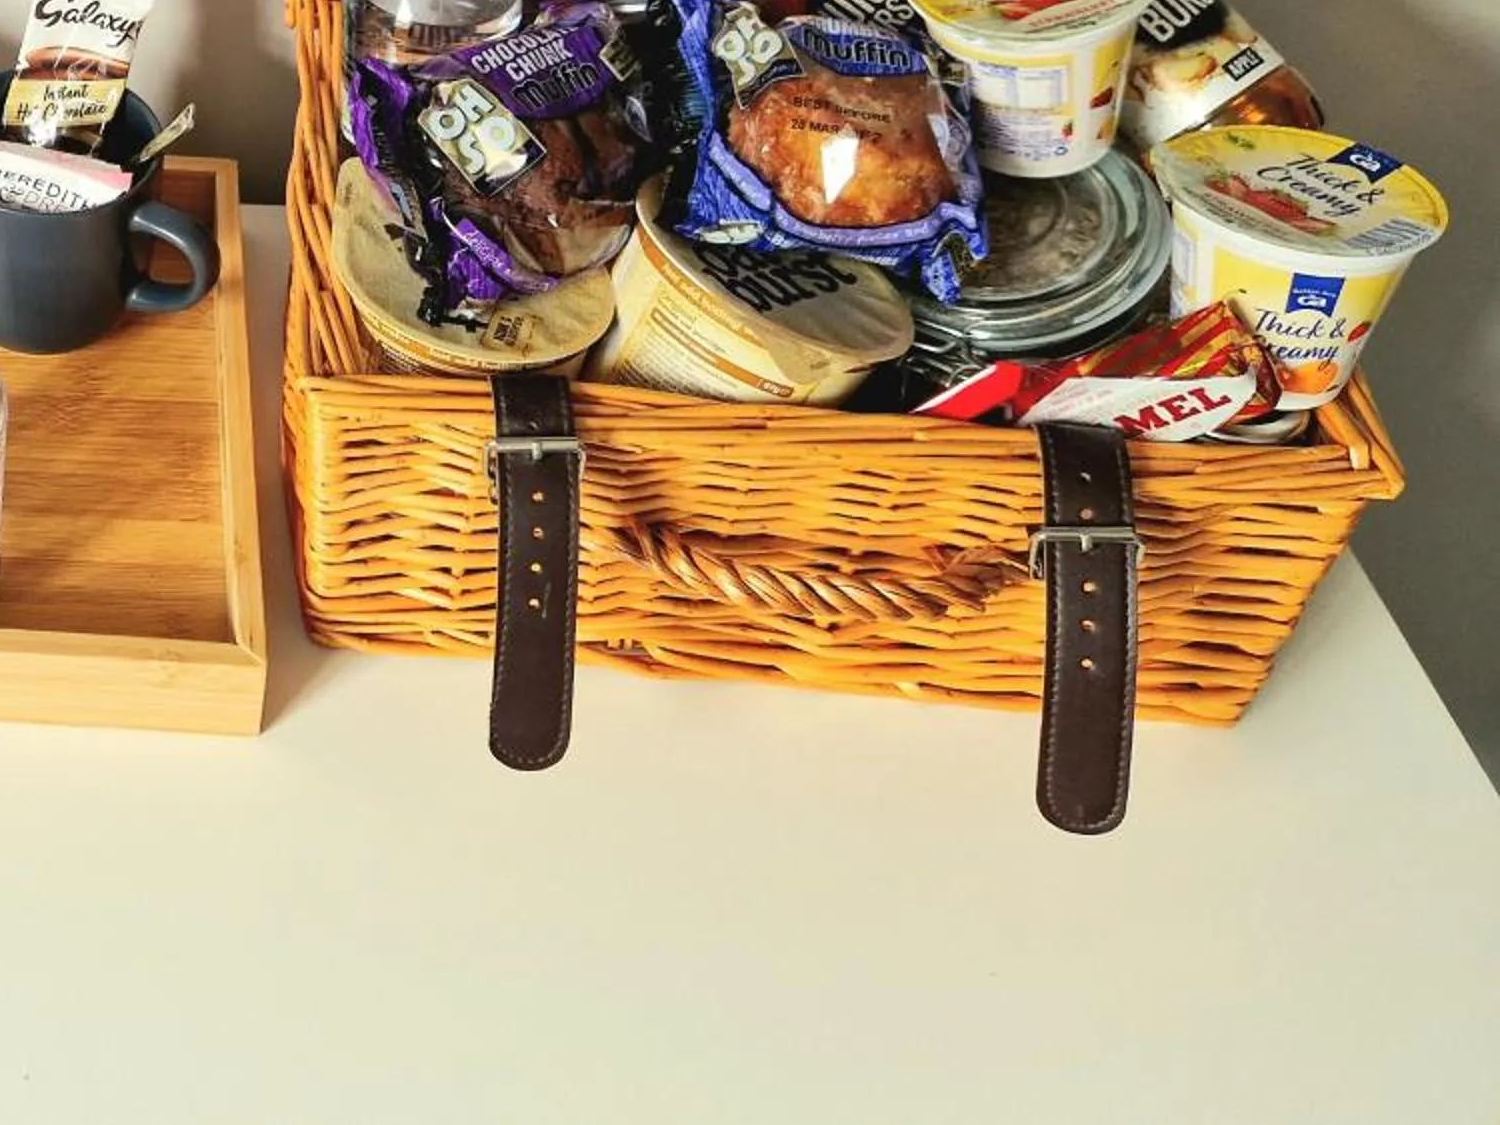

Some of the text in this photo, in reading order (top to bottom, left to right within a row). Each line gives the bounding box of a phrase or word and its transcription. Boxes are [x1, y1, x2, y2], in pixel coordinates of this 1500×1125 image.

[505, 38, 573, 81] CHUNK
[1256, 166, 1362, 218] Creamy
[1285, 152, 1360, 194] Thick
[1256, 308, 1347, 340] Thick &
[1258, 337, 1339, 370] reamy
